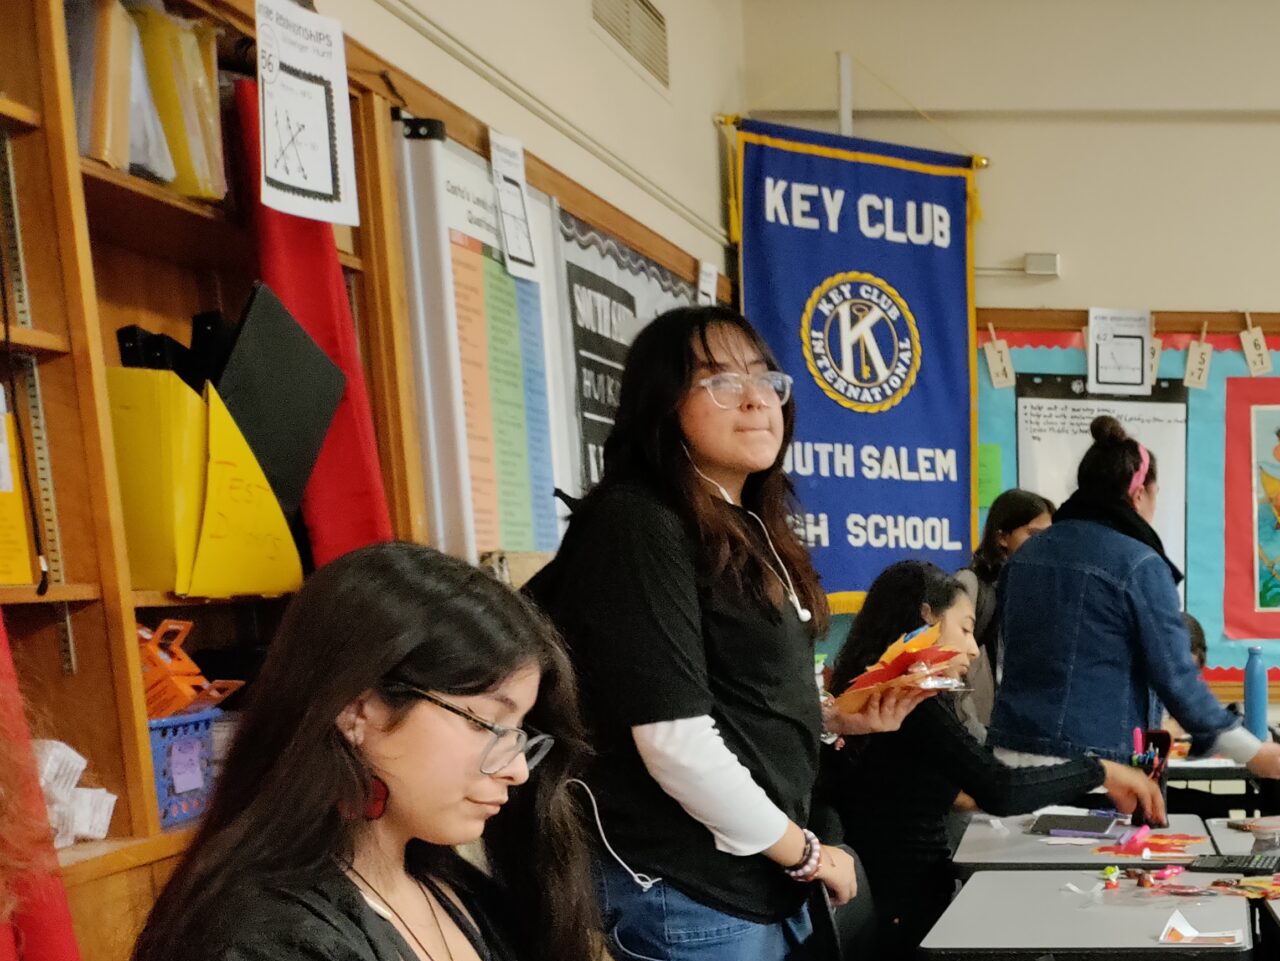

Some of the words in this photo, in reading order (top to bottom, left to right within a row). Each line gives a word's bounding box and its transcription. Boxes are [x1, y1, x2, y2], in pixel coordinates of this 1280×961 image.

[765, 177, 845, 233] KEY
[857, 194, 951, 249] CLUB
[818, 284, 852, 317] KEY
[859, 285, 900, 322] CLUB
[811, 330, 912, 403] INTERNATIONAL
[837, 301, 890, 385] K
[783, 441, 855, 478] OUTH
[860, 445, 957, 482] SALEM
[846, 513, 963, 551] SCHOOL
